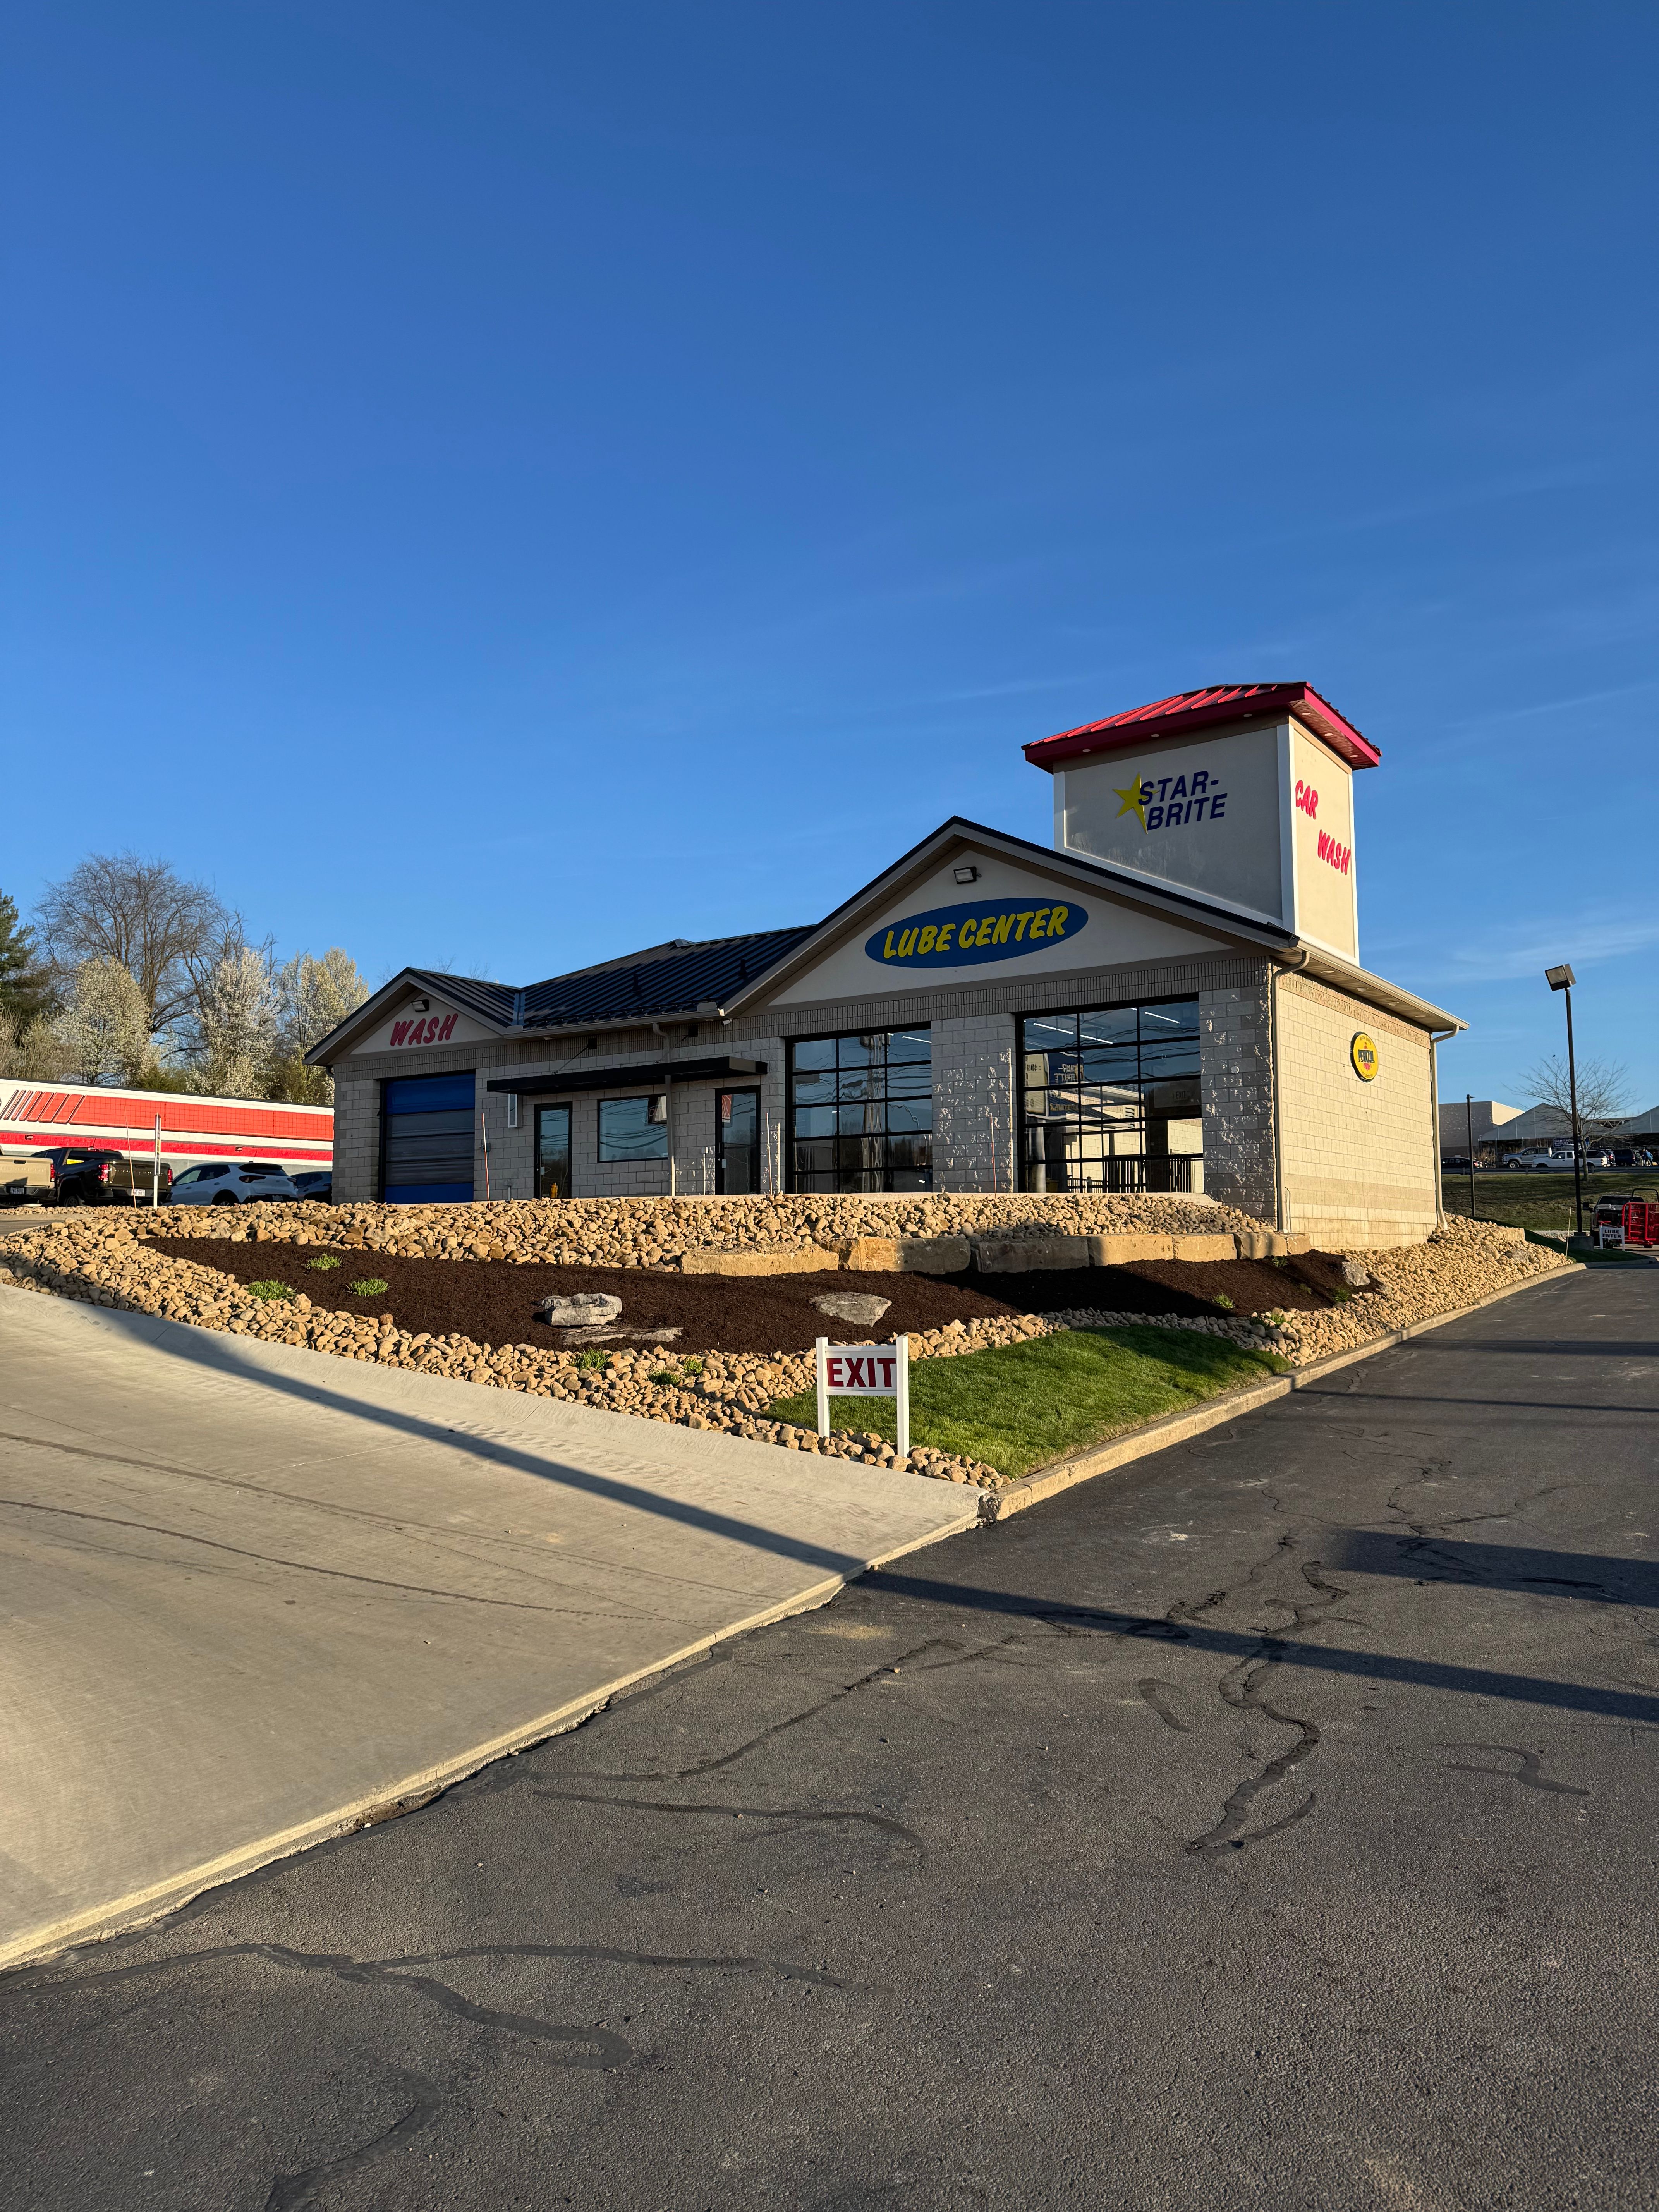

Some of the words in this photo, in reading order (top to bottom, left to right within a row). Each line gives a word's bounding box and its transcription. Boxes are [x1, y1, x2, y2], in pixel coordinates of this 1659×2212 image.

[1138, 771, 1219, 806] STAR-
[1295, 780, 1319, 820] CAR
[1147, 793, 1228, 831] BRITE
[1317, 830, 1351, 876] WASH
[883, 923, 956, 959] LUBE
[958, 905, 1069, 949] CENTER
[390, 1013, 459, 1047] WASH
[826, 1358, 896, 1388] EXIT
